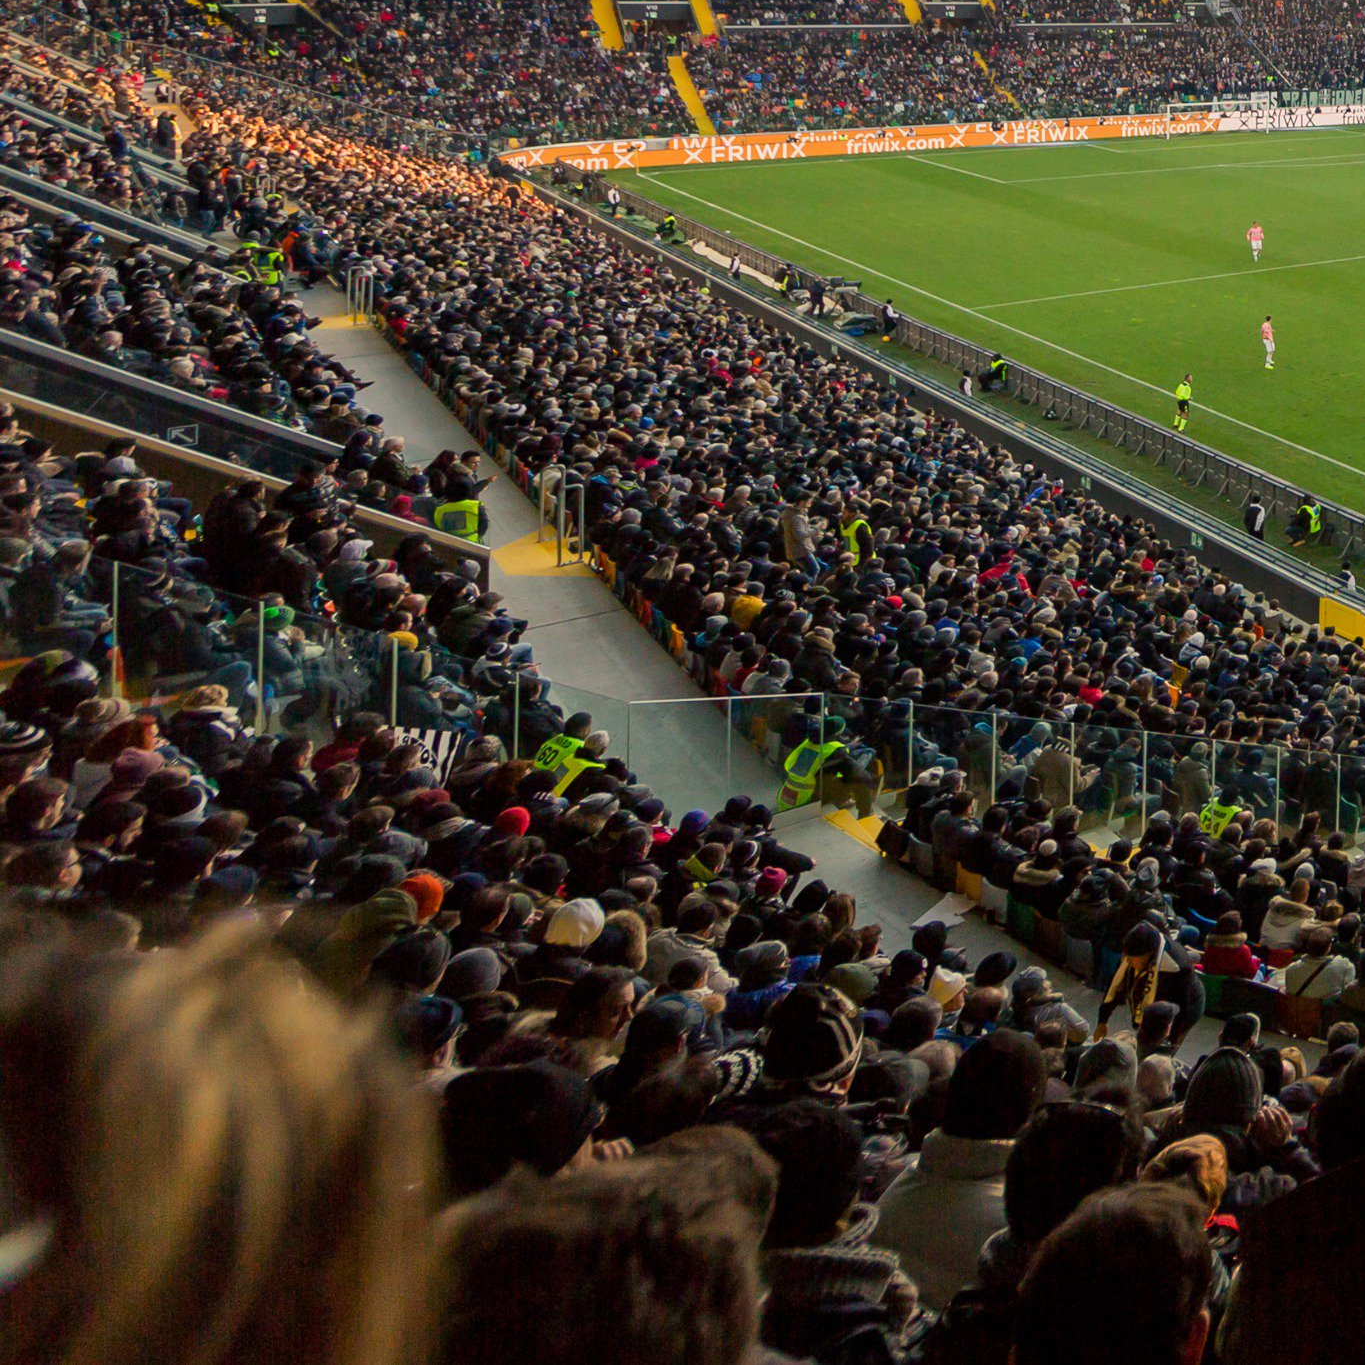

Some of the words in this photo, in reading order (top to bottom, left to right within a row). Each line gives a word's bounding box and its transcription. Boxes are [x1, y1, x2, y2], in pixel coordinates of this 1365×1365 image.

[711, 141, 807, 163] FRIWIX
[846, 136, 945, 155] friwix.com
[1014, 125, 1090, 144] FRIWIX
[1121, 121, 1200, 138] friwix.com
